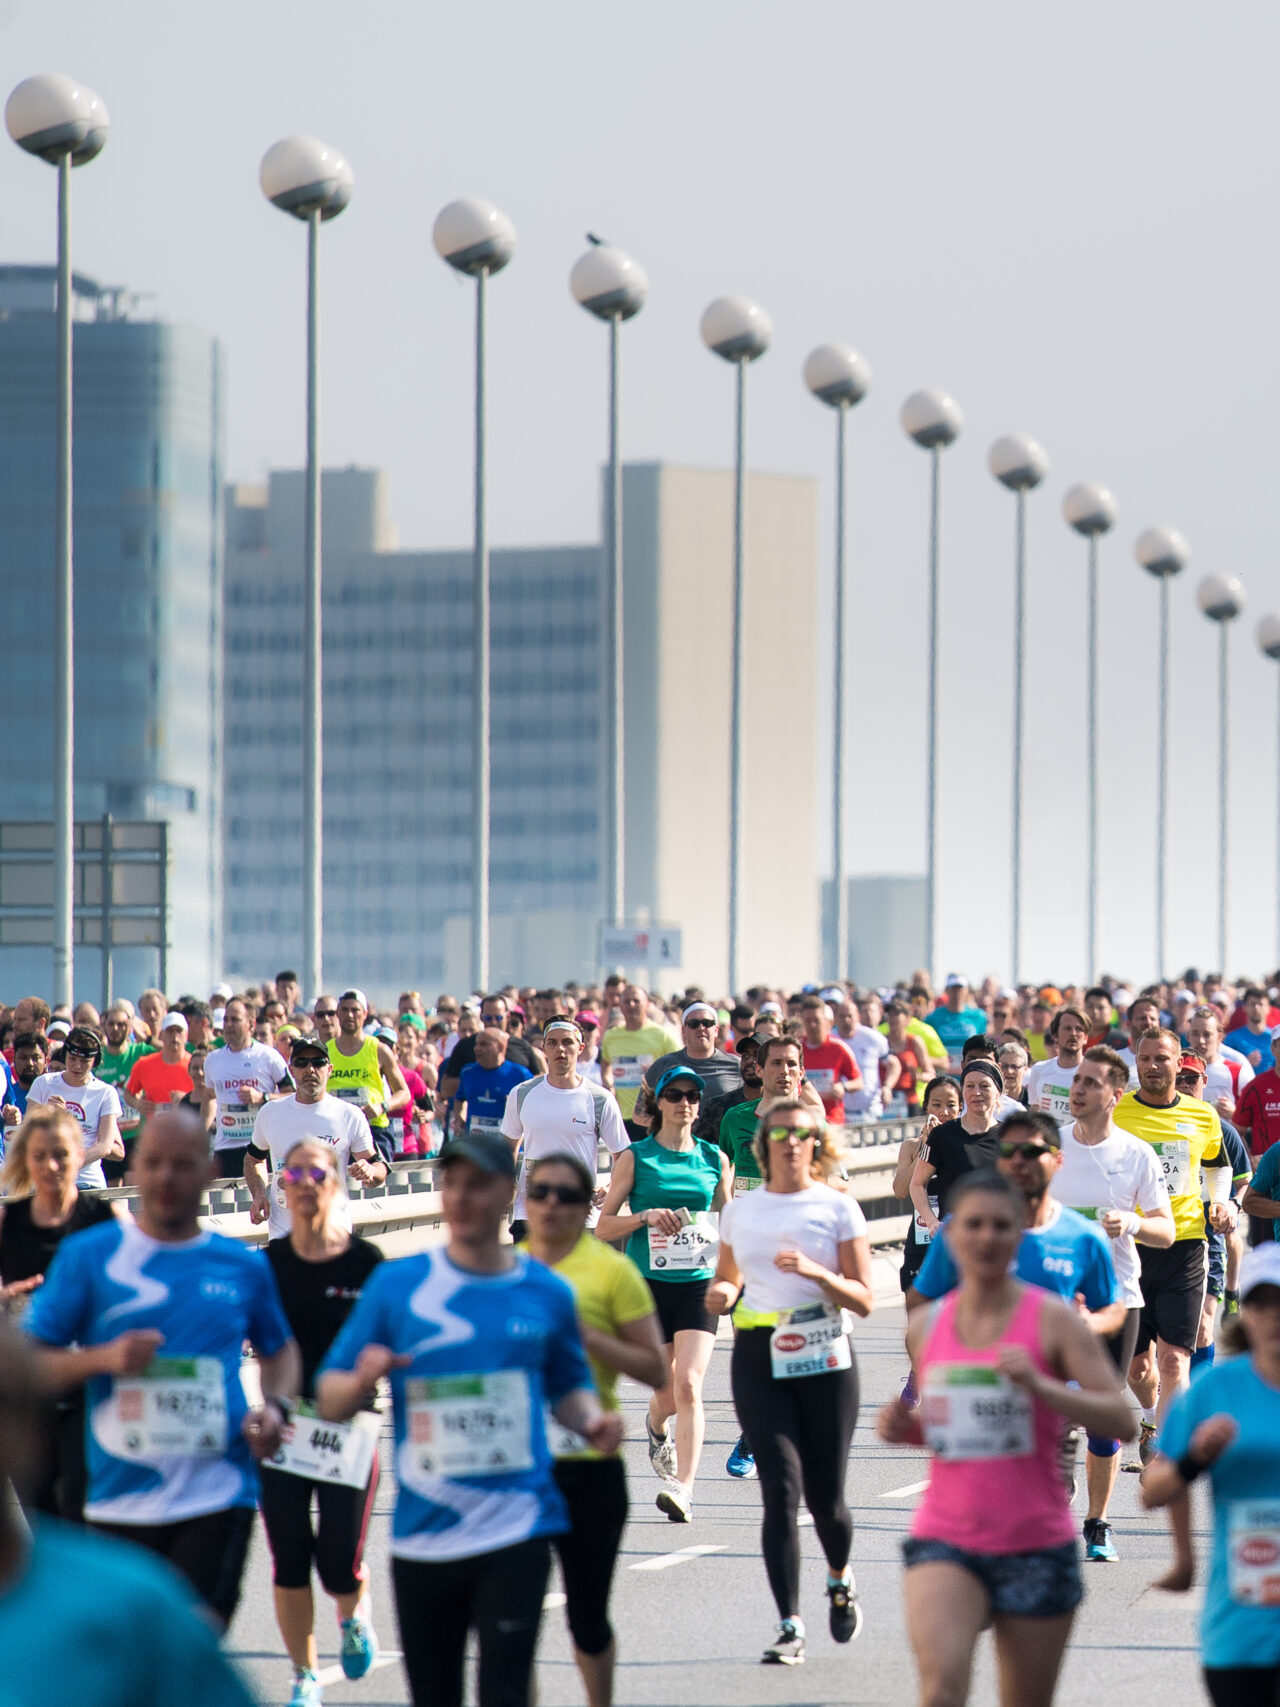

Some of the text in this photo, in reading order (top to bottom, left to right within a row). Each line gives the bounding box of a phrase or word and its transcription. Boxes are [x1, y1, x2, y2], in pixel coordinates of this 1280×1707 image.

[328, 1069, 362, 1079] CRAFT
[224, 1079, 259, 1089] BOSCH
[673, 1232, 704, 1245] 2516
[785, 1358, 824, 1375] ERSTE
